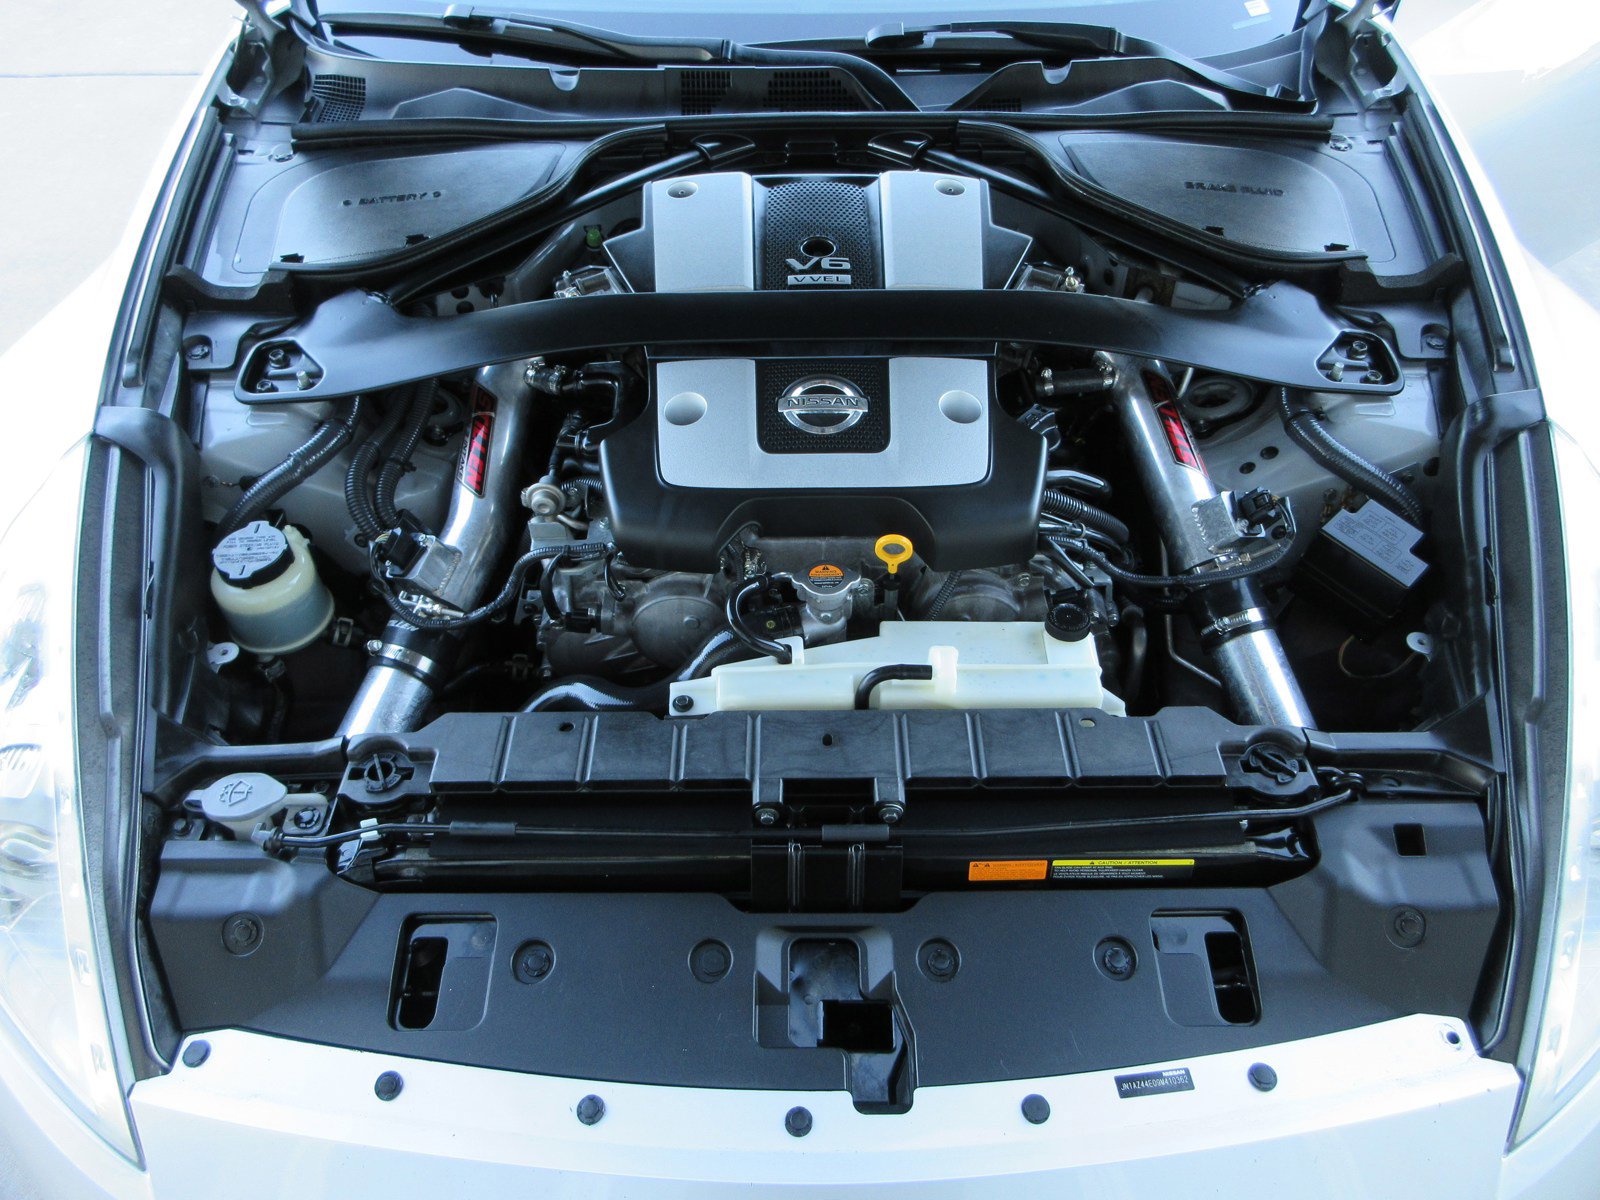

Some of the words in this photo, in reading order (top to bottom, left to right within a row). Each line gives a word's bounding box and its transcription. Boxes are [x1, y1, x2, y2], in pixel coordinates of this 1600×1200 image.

[359, 191, 428, 206] BATTERY
[784, 256, 851, 271] V6
[793, 275, 846, 283] VVEL
[786, 397, 860, 407] NISSAN
[1162, 1069, 1186, 1077] NISSAN
